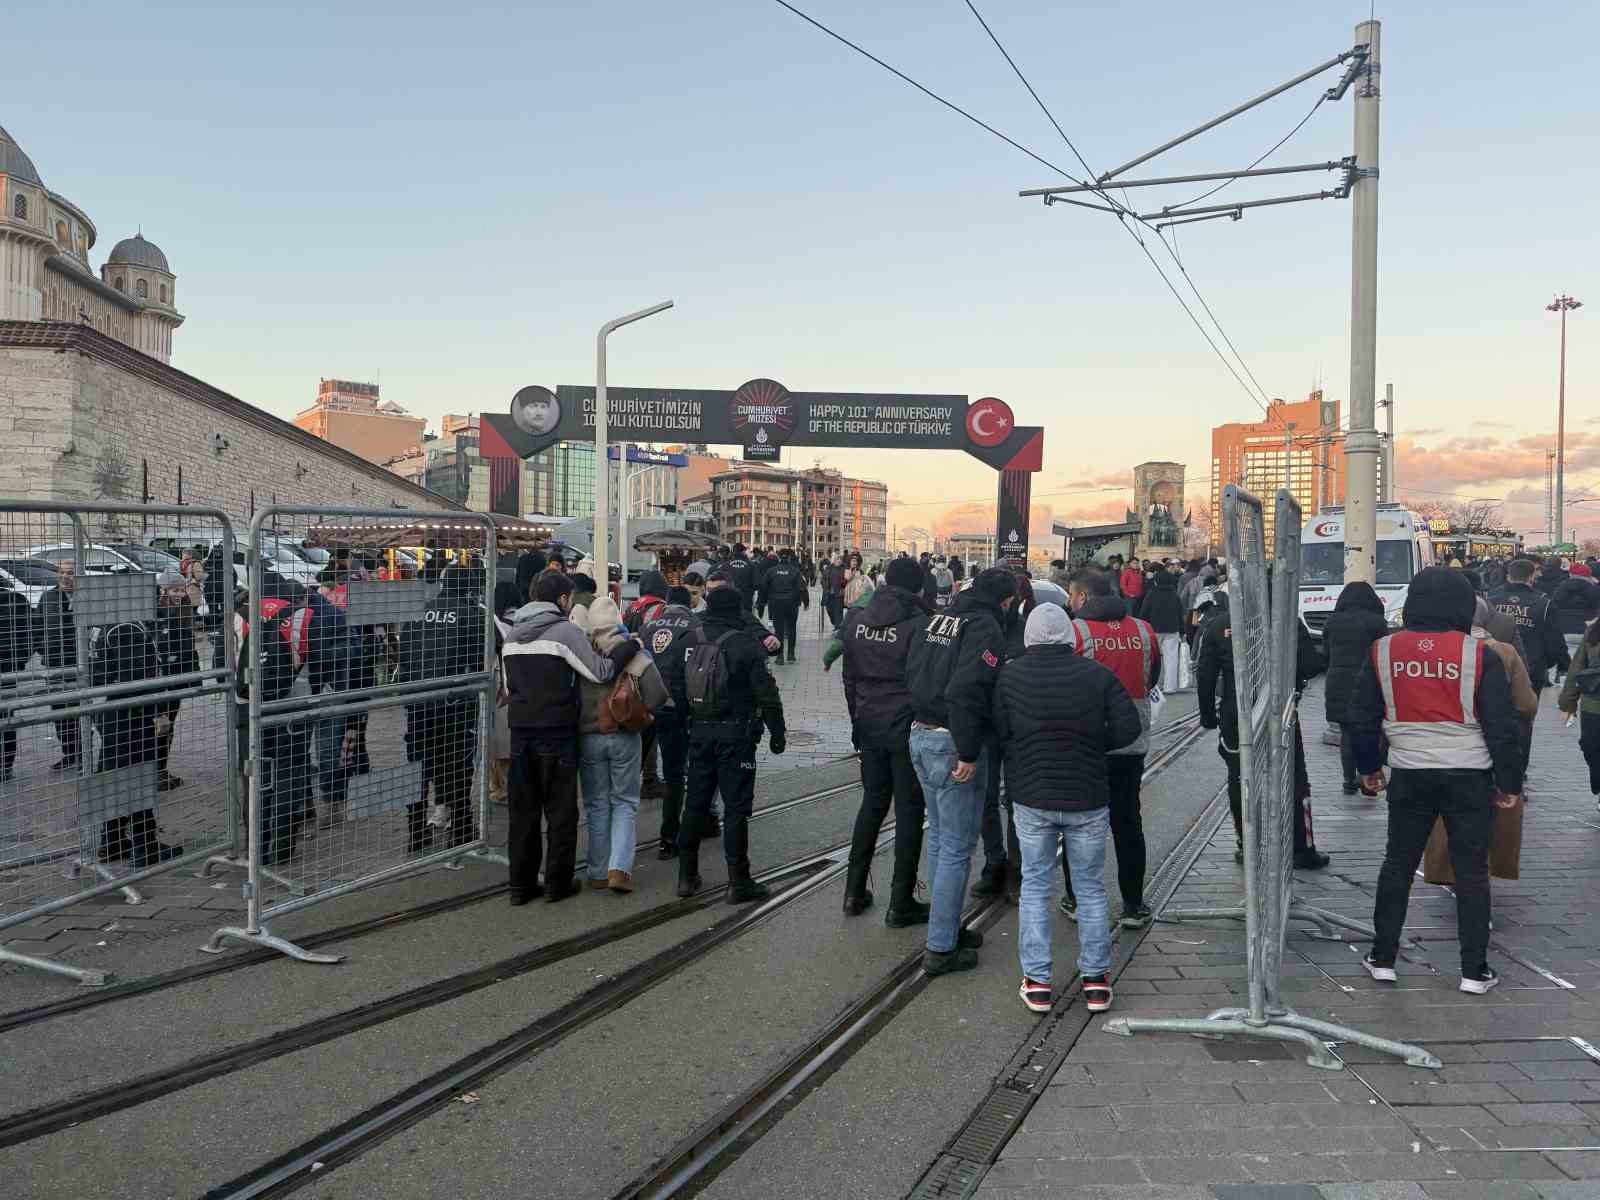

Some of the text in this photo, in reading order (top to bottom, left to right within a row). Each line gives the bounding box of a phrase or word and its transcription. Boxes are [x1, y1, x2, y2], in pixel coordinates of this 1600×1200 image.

[583, 398, 701, 415] CUHURİYETİMİZİN
[809, 404, 845, 418] HAPPY
[875, 406, 953, 420] ANNIVERSARY
[628, 415, 663, 428] KUTLU
[665, 416, 701, 429] OLSUN
[809, 420, 952, 435] OF THE REPUBLIC OF TÜRKİYE
[425, 610, 457, 623] OLİS
[1392, 657, 1460, 680] POLİS
